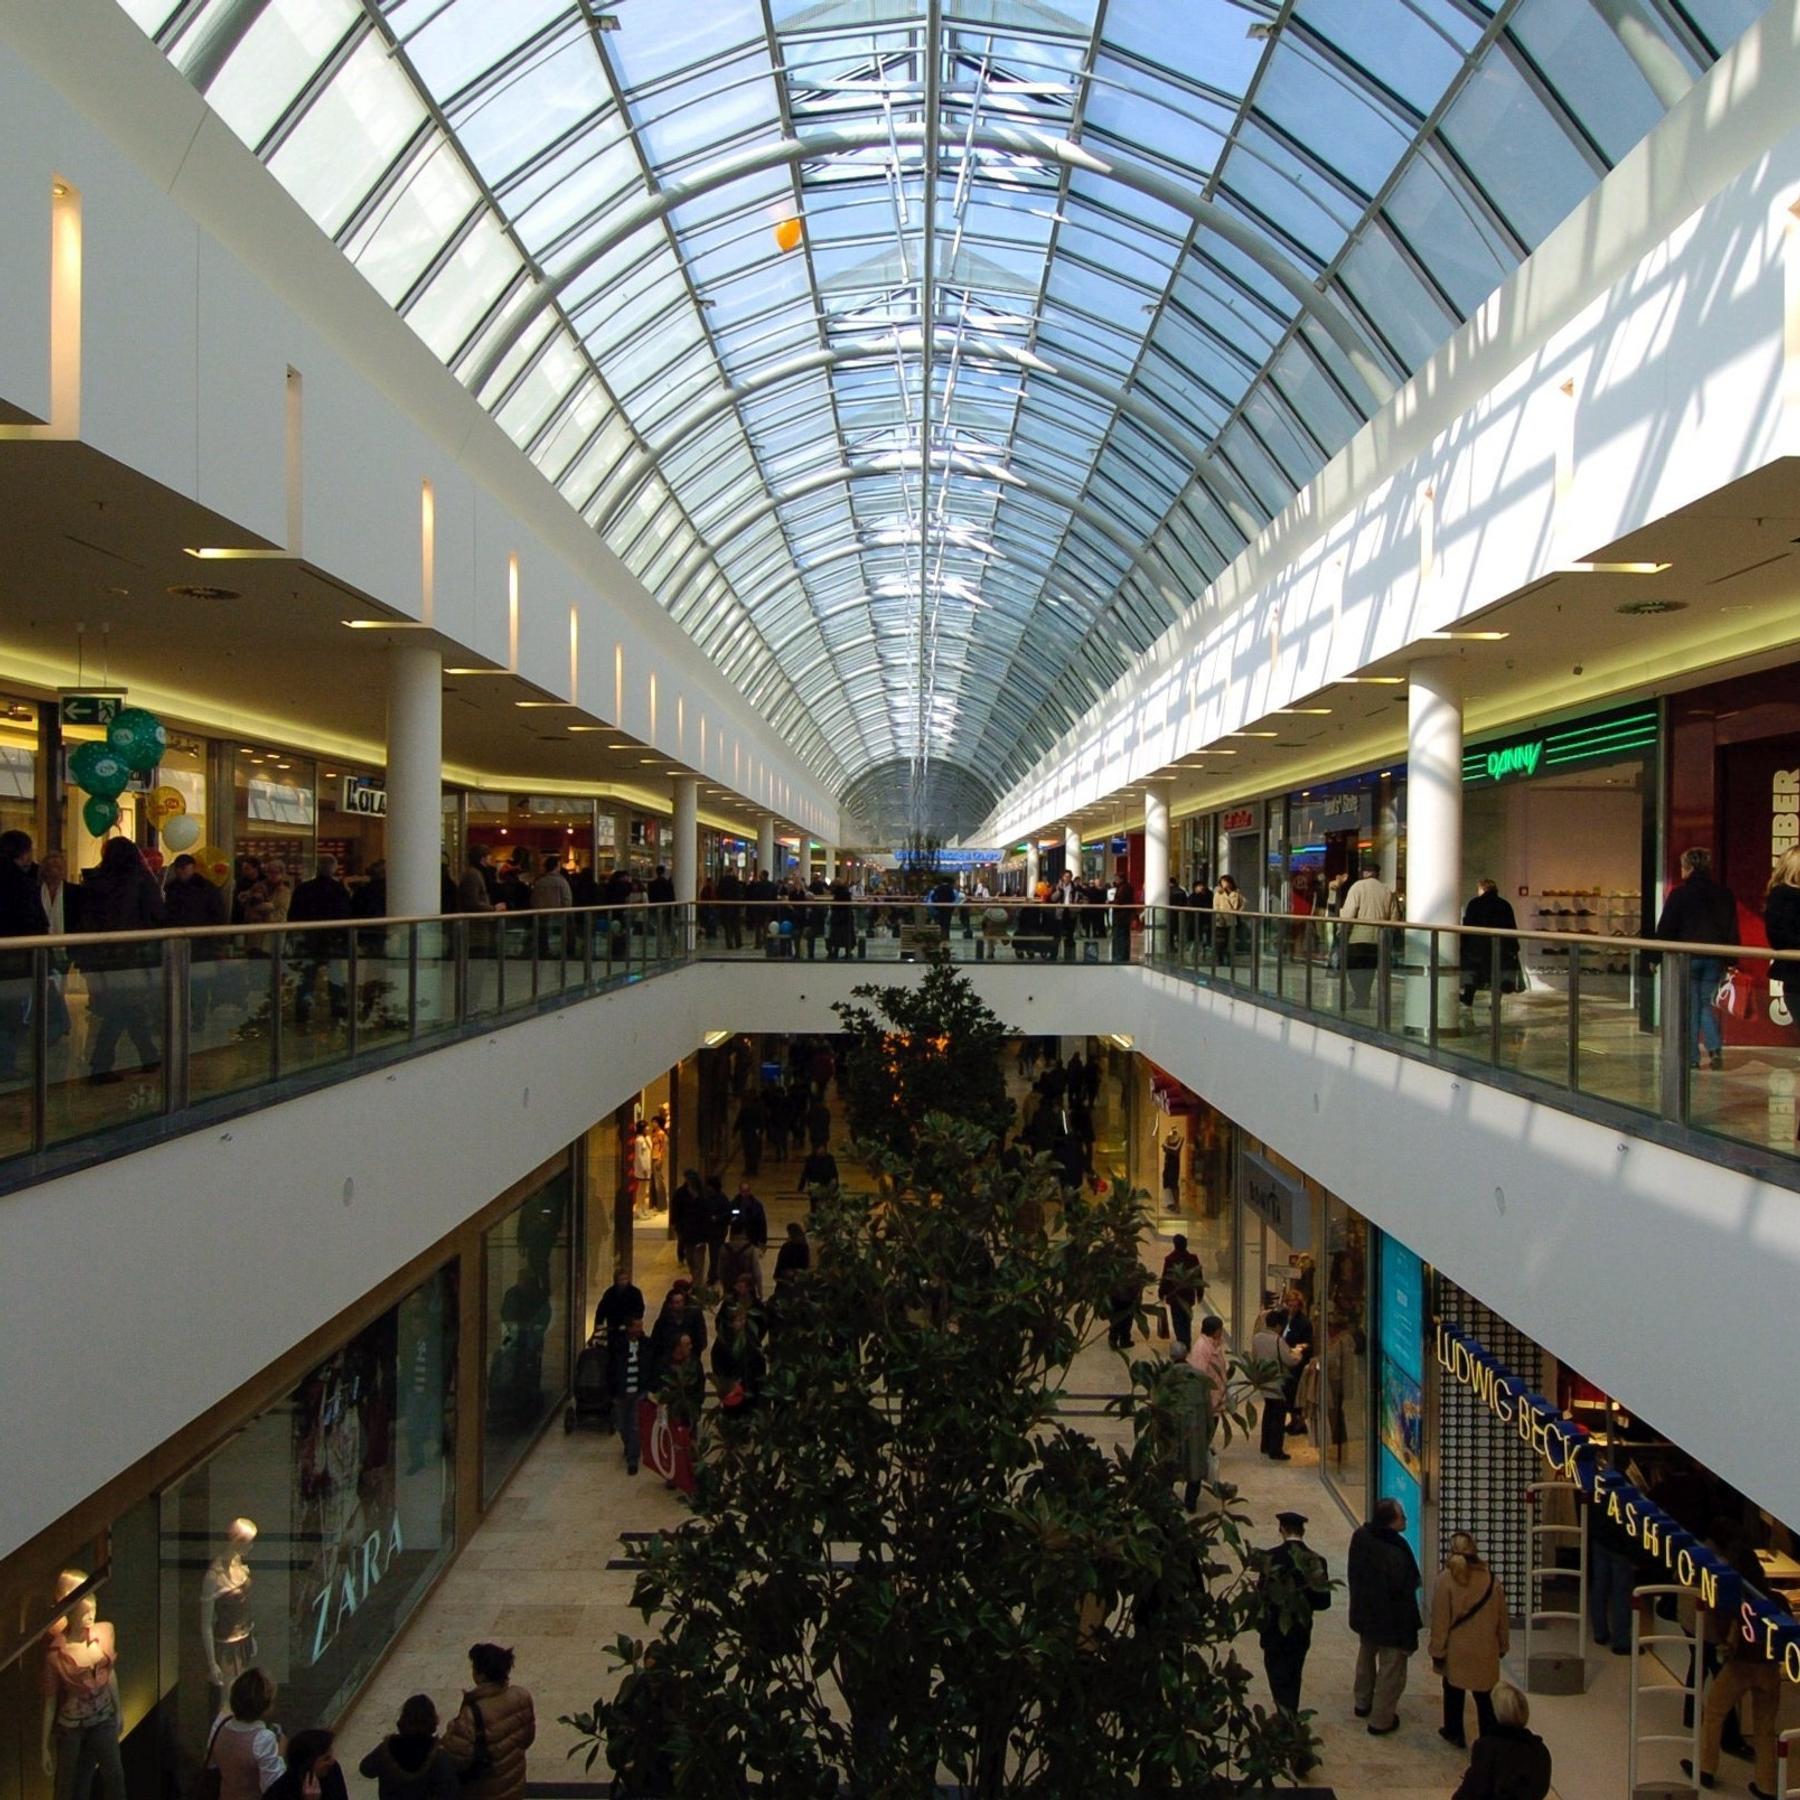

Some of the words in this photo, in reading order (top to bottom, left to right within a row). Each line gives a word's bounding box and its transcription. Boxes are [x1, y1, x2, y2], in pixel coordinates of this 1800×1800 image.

[1487, 739, 1543, 781] DANNY
[1771, 768, 1800, 868] EBER
[1437, 1324, 1513, 1422] LUDWIG
[1518, 1394, 1583, 1489] BECK
[1593, 1474, 1719, 1609] FASHION
[311, 1508, 403, 1667] ZARA
